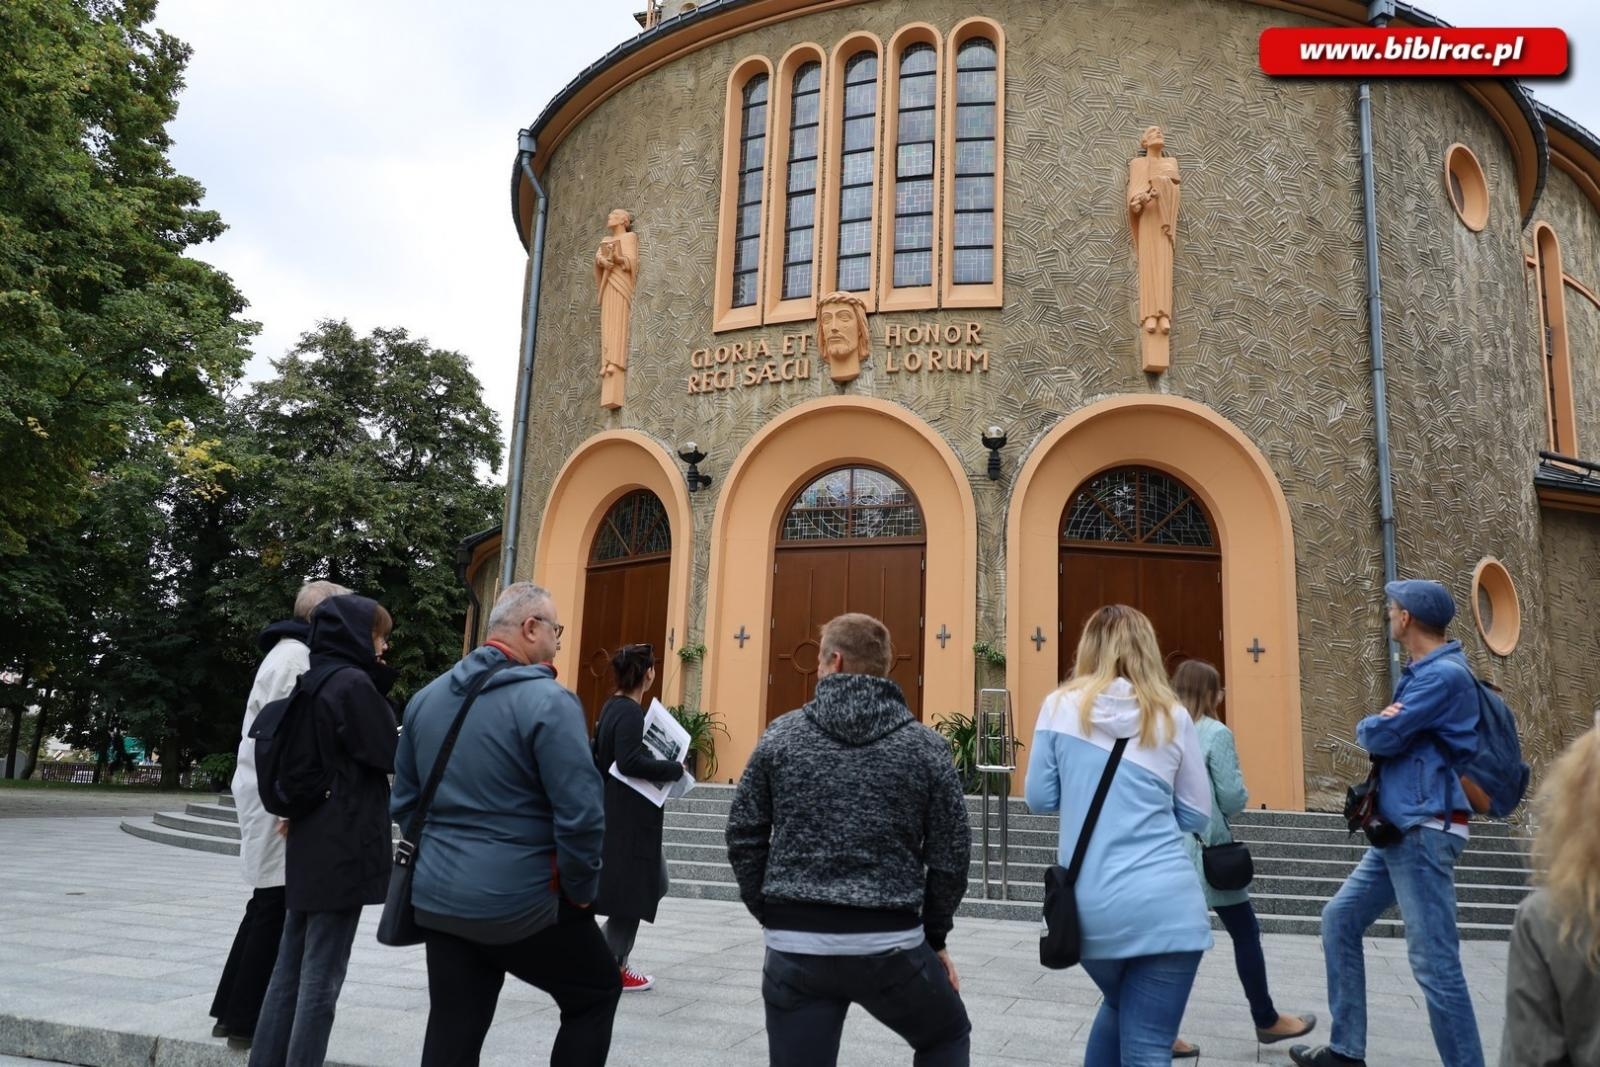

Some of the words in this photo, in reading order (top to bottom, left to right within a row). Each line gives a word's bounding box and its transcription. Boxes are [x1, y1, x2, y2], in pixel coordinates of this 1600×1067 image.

[691, 337, 772, 369] GLORIA
[783, 334, 812, 356] ET
[885, 322, 982, 348] HONOR
[688, 368, 737, 395] REGI
[886, 348, 990, 373] LORUM
